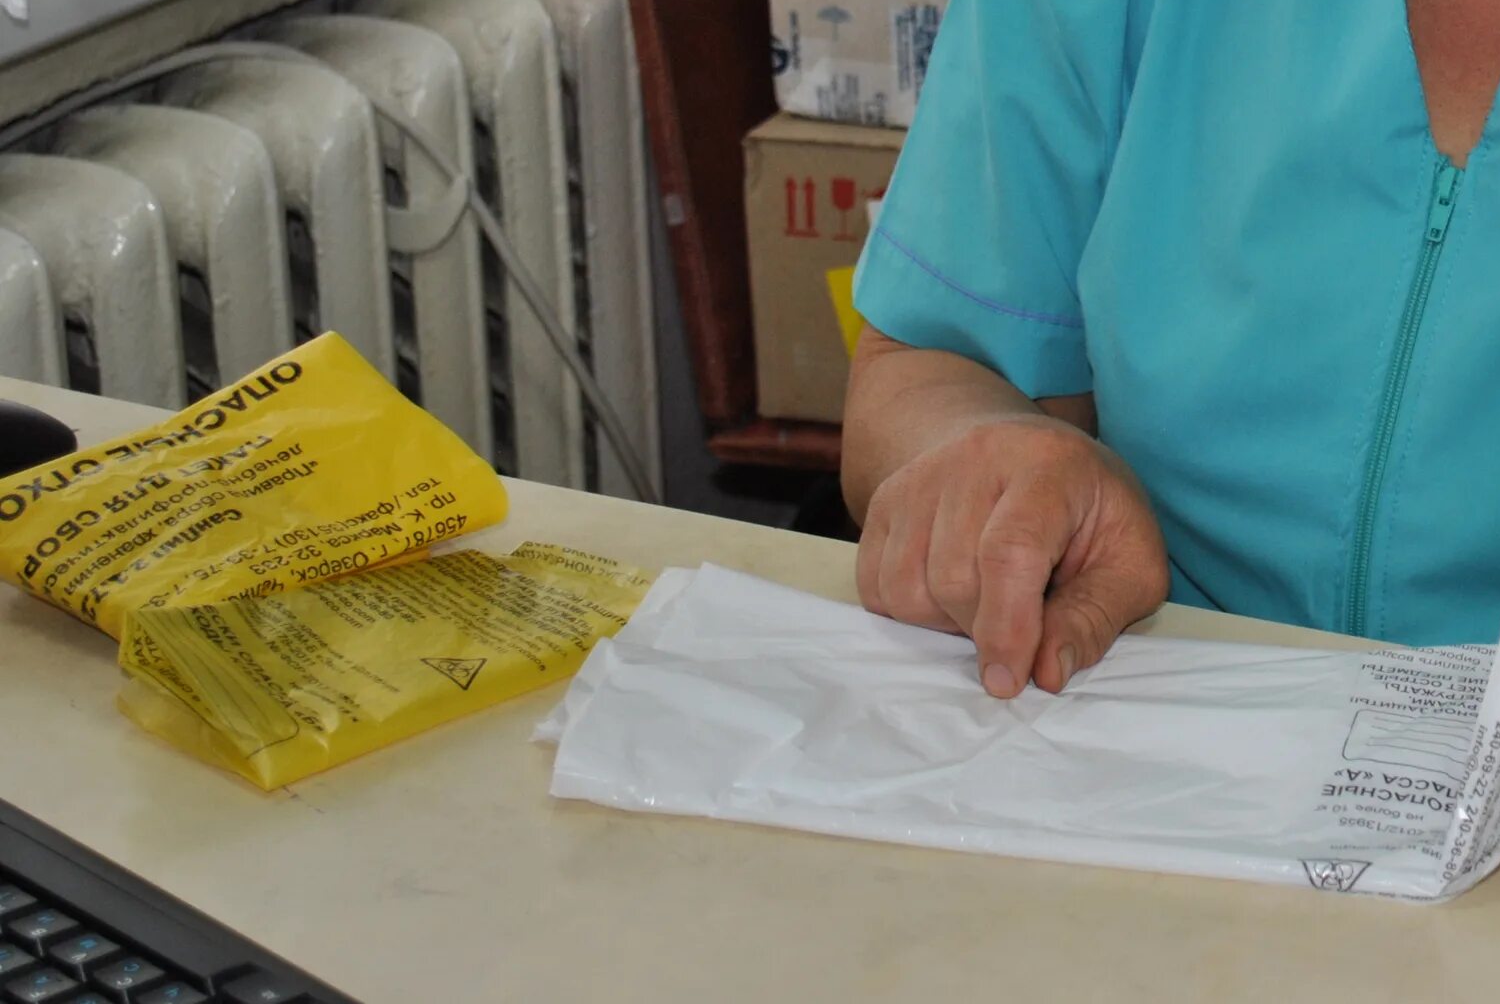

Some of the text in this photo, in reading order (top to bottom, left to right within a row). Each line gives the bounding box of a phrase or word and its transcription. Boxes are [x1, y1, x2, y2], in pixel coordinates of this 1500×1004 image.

[104, 360, 303, 462] ОПАСНЫЕ
[178, 435, 273, 478] ПАКЕТ
[103, 471, 171, 514] ДЛЯ
[249, 491, 456, 576] пр. К. Маркса, 32-233
[63, 527, 158, 596] хранения
[291, 550, 370, 583] Озерск,
[1360, 663, 1454, 682] ПРЕДМЕТЫ
[1354, 803, 1402, 820] более
[1405, 812, 1425, 822] не
